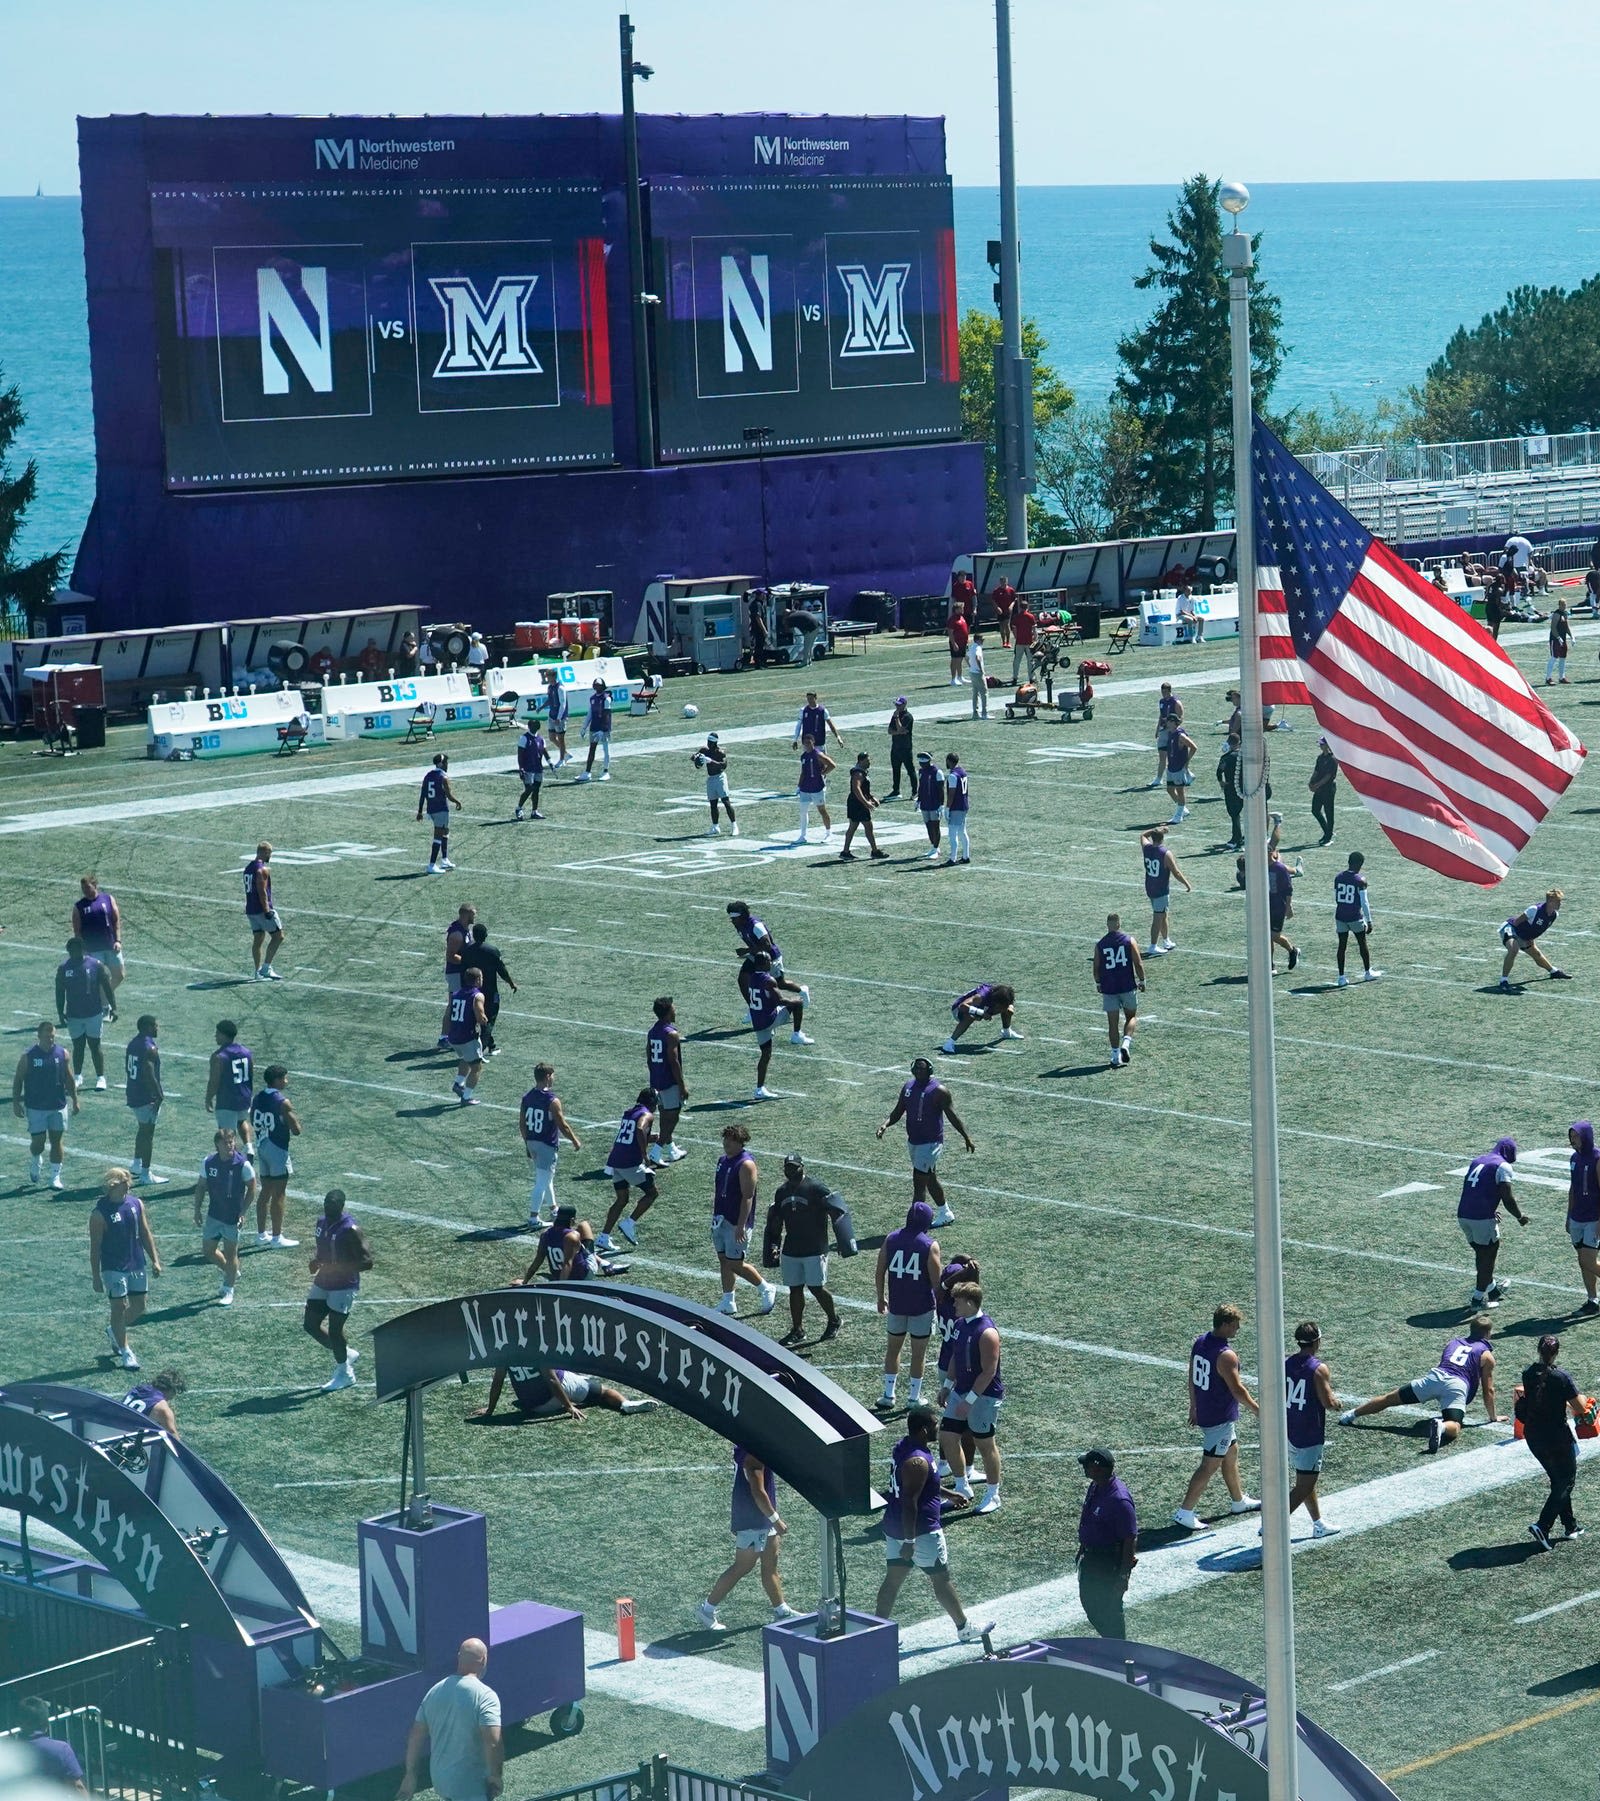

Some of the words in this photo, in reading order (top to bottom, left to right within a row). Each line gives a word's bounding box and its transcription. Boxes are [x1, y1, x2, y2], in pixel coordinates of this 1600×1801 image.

[359, 138, 455, 153] Northwestern
[784, 136, 849, 151] Northwestern
[360, 156, 419, 170] Medicine
[784, 152, 825, 166] Medicine
[721, 254, 773, 374] N
[802, 304, 821, 322] VS
[836, 263, 915, 358] M
[256, 267, 333, 394] N
[378, 320, 405, 339] VS
[428, 275, 544, 378] M
[777, 437, 814, 445] REDHAWKS
[848, 431, 884, 440] REDHAWKS
[916, 426, 951, 435] REDHAWKS
[192, 473, 224, 482] MIAMI
[230, 471, 286, 480] REDHAWKS
[302, 468, 332, 476] MIAMI
[339, 465, 393, 474] REDHAWKS
[444, 459, 497, 468] REDHAWKS
[511, 456, 540, 464] MIAMI
[545, 453, 597, 462] REDHAWKS
[428, 781, 436, 798] 5
[1144, 856, 1160, 878] 39
[1336, 882, 1356, 904] 28
[1102, 944, 1129, 970] 34
[450, 998, 467, 1023] 31
[231, 1057, 250, 1085] 51
[524, 1106, 544, 1134] 48
[616, 1119, 637, 1145] 23
[1467, 1163, 1485, 1188] 4
[889, 1249, 921, 1283] 44
[459, 1296, 743, 1419] Northwestern
[363, 1537, 418, 1655] N
[769, 1643, 819, 1762] N
